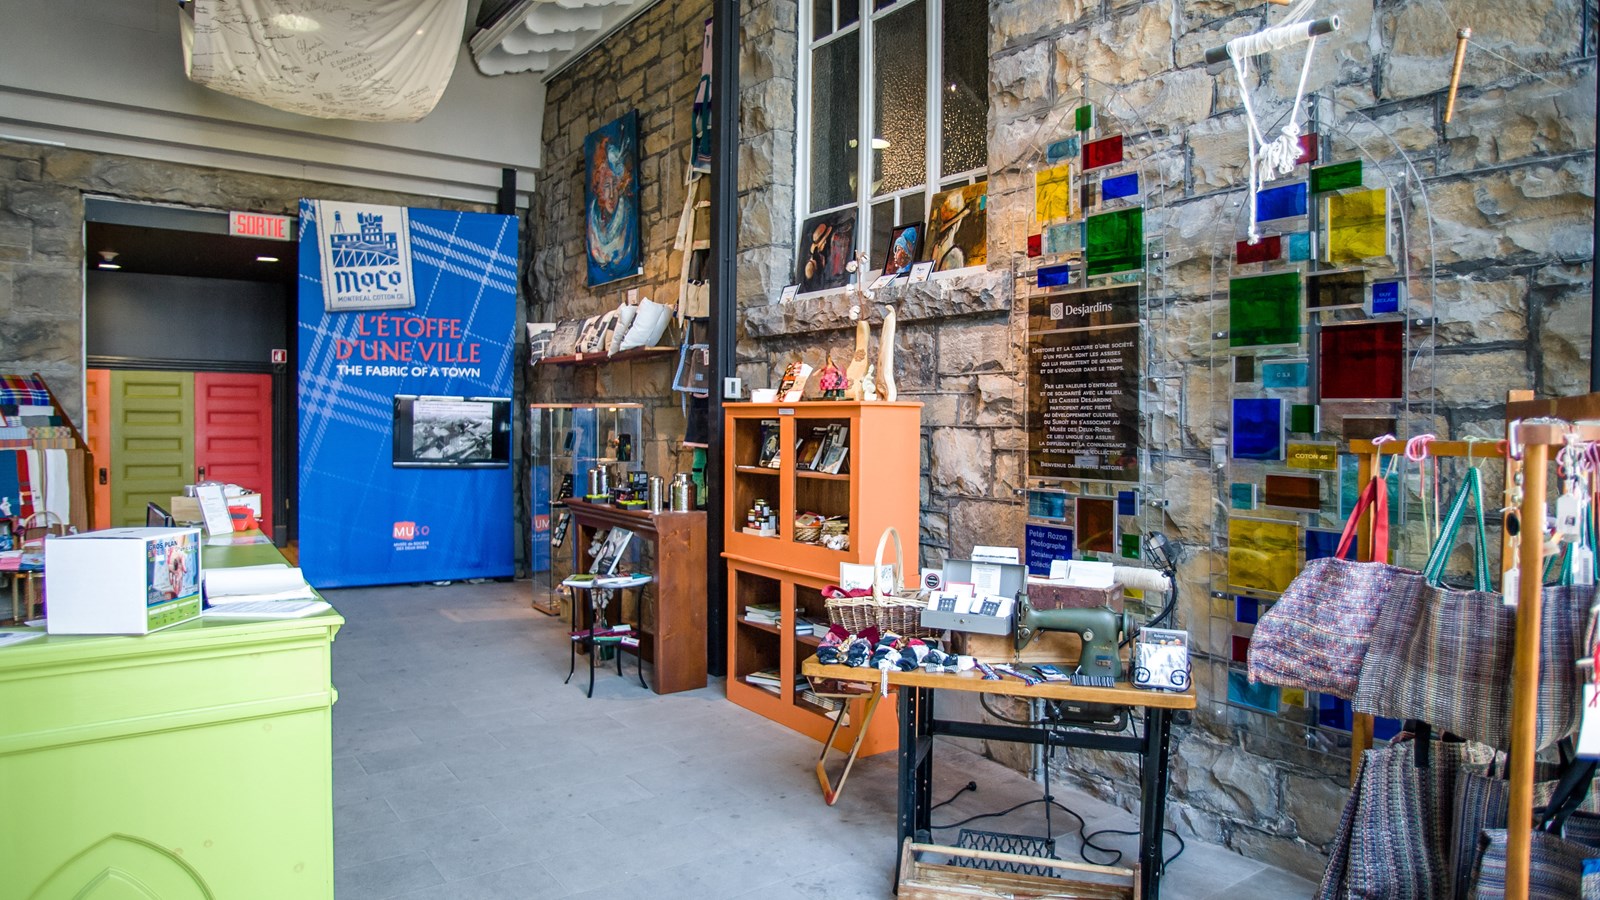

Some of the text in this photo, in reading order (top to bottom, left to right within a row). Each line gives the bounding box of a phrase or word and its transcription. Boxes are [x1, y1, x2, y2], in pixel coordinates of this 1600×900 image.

[236, 214, 286, 238] SORTIE
[1065, 302, 1112, 317] Desjardins
[359, 312, 461, 338] L'ÉTOFFE
[336, 340, 481, 363] D'UNE VILLE
[337, 365, 480, 377] THE FABRIC OF A TOWN
[1048, 532, 1067, 540] Rozon
[149, 542, 163, 551] GROS
[1031, 540, 1065, 550] Photographe
